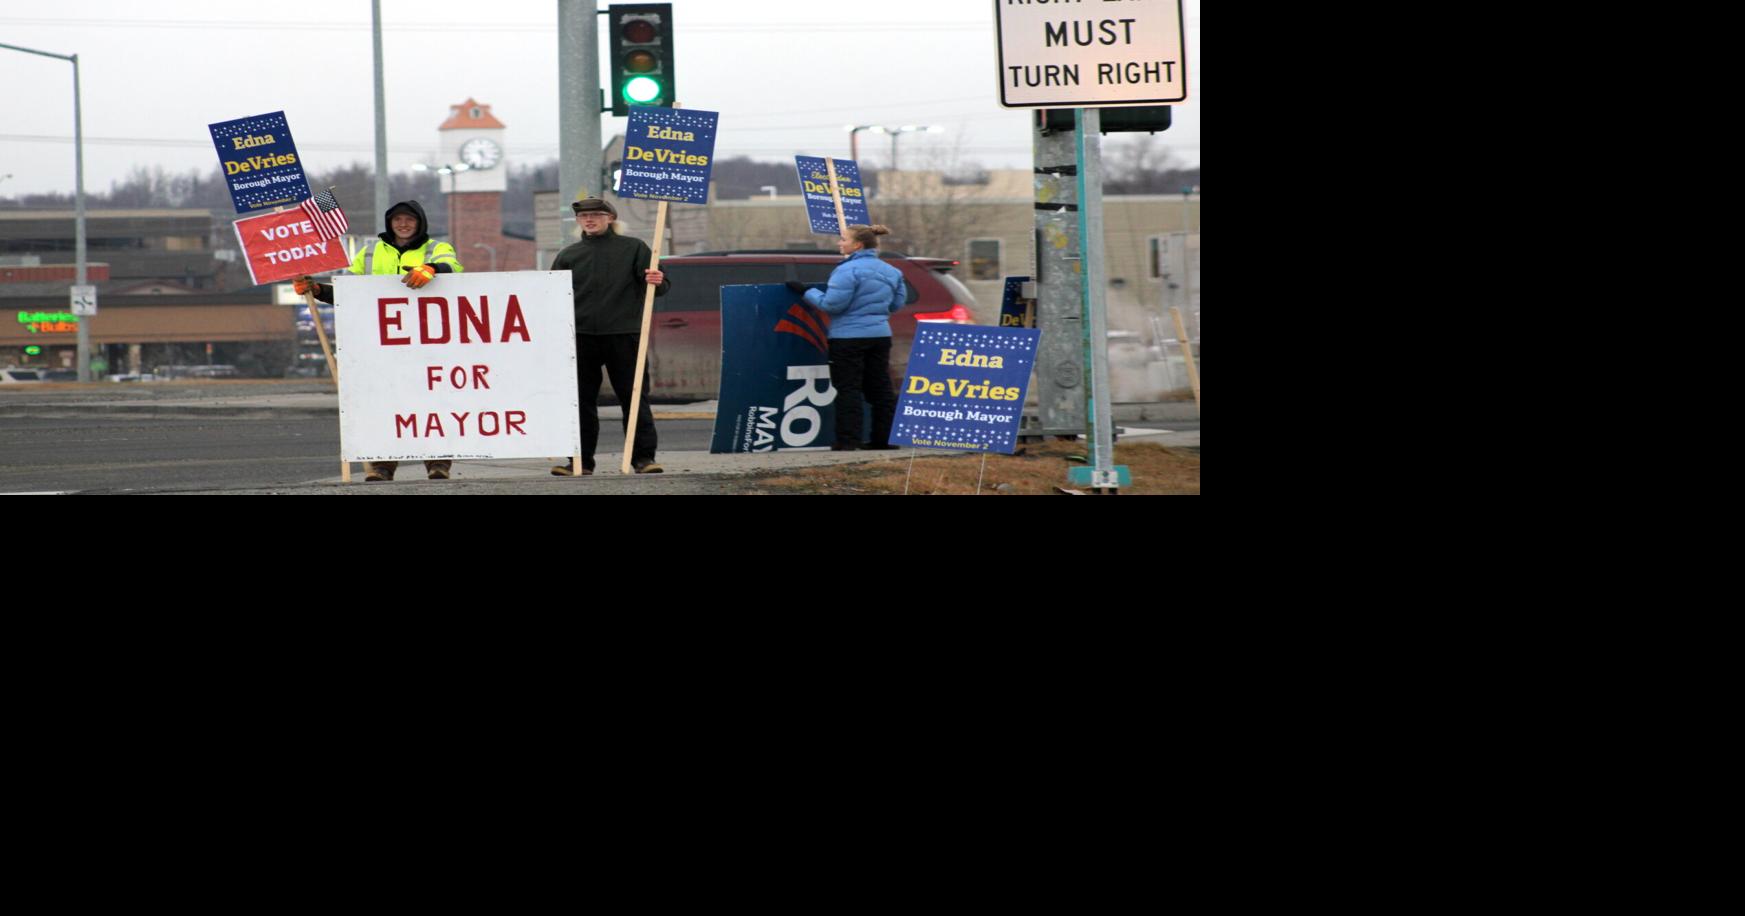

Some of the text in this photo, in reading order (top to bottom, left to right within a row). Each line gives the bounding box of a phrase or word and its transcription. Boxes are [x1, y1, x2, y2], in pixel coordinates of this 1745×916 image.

[1045, 19, 1136, 47] MUST
[1008, 61, 1176, 87] TURN RIGHT
[232, 133, 276, 150] Edna
[646, 125, 695, 142] Edna
[225, 152, 297, 175] DeVries
[626, 146, 709, 166] DeVries
[233, 173, 301, 191] Borough Mayor
[625, 168, 705, 183] Borough Mayor
[803, 181, 862, 198] DeVies
[806, 193, 834, 203] Boroug
[261, 220, 315, 241] VOTE
[264, 242, 329, 265] TODAY
[377, 294, 532, 346] EDNA
[937, 348, 1004, 368] Edna
[427, 365, 490, 391] FOR
[906, 375, 1020, 401] DeVries
[395, 410, 527, 439] MAYOR
[903, 406, 1013, 424] Borough Mayor
[911, 437, 933, 446] Vote
[933, 439, 981, 449] November
